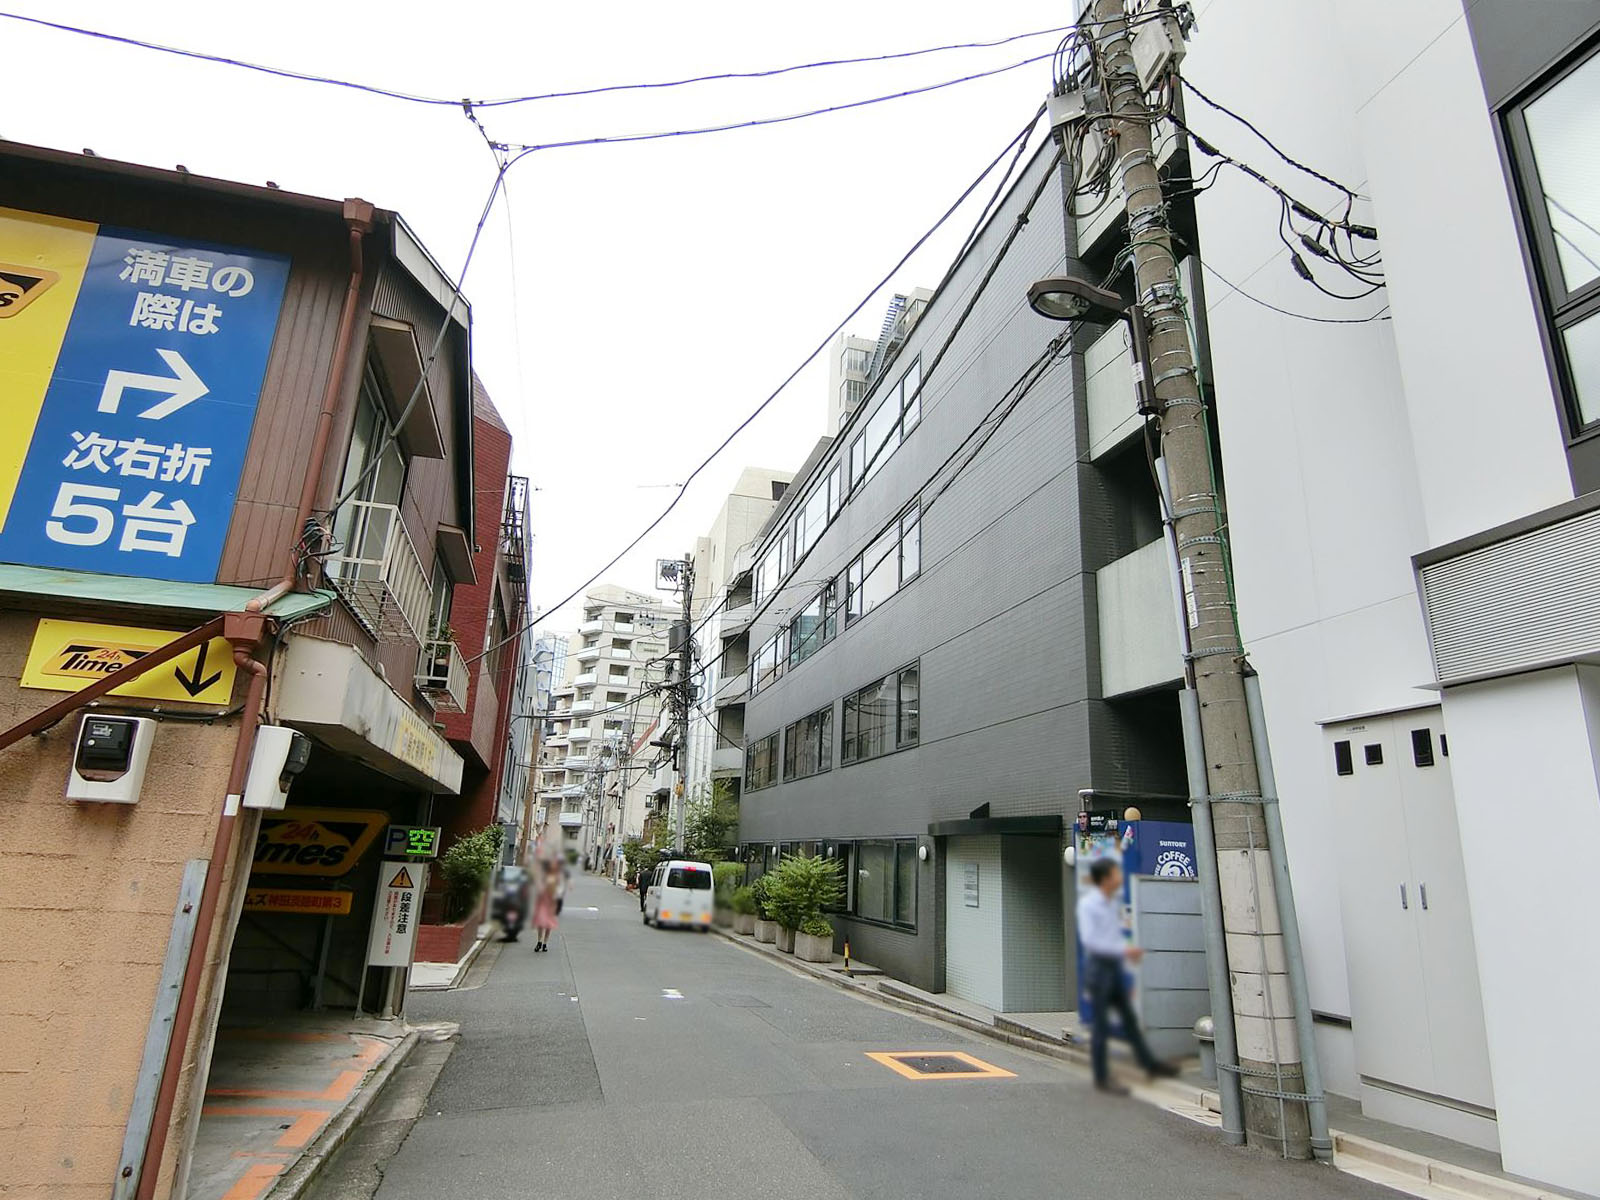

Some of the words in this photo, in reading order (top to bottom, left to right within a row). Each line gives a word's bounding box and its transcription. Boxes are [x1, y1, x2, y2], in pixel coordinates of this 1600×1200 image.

[118, 247, 255, 298] 満車の
[128, 291, 223, 335] 際は
[62, 430, 213, 486] 次右折
[45, 481, 197, 558] 5台
[60, 652, 124, 675] Time
[96, 648, 121, 661] 24h
[255, 833, 349, 866] mes
[388, 828, 407, 851] P
[406, 828, 436, 855] 空
[1159, 840, 1187, 848] SUNTORY
[1157, 850, 1191, 867] COFFEE
[395, 891, 413, 935] 段差注意
